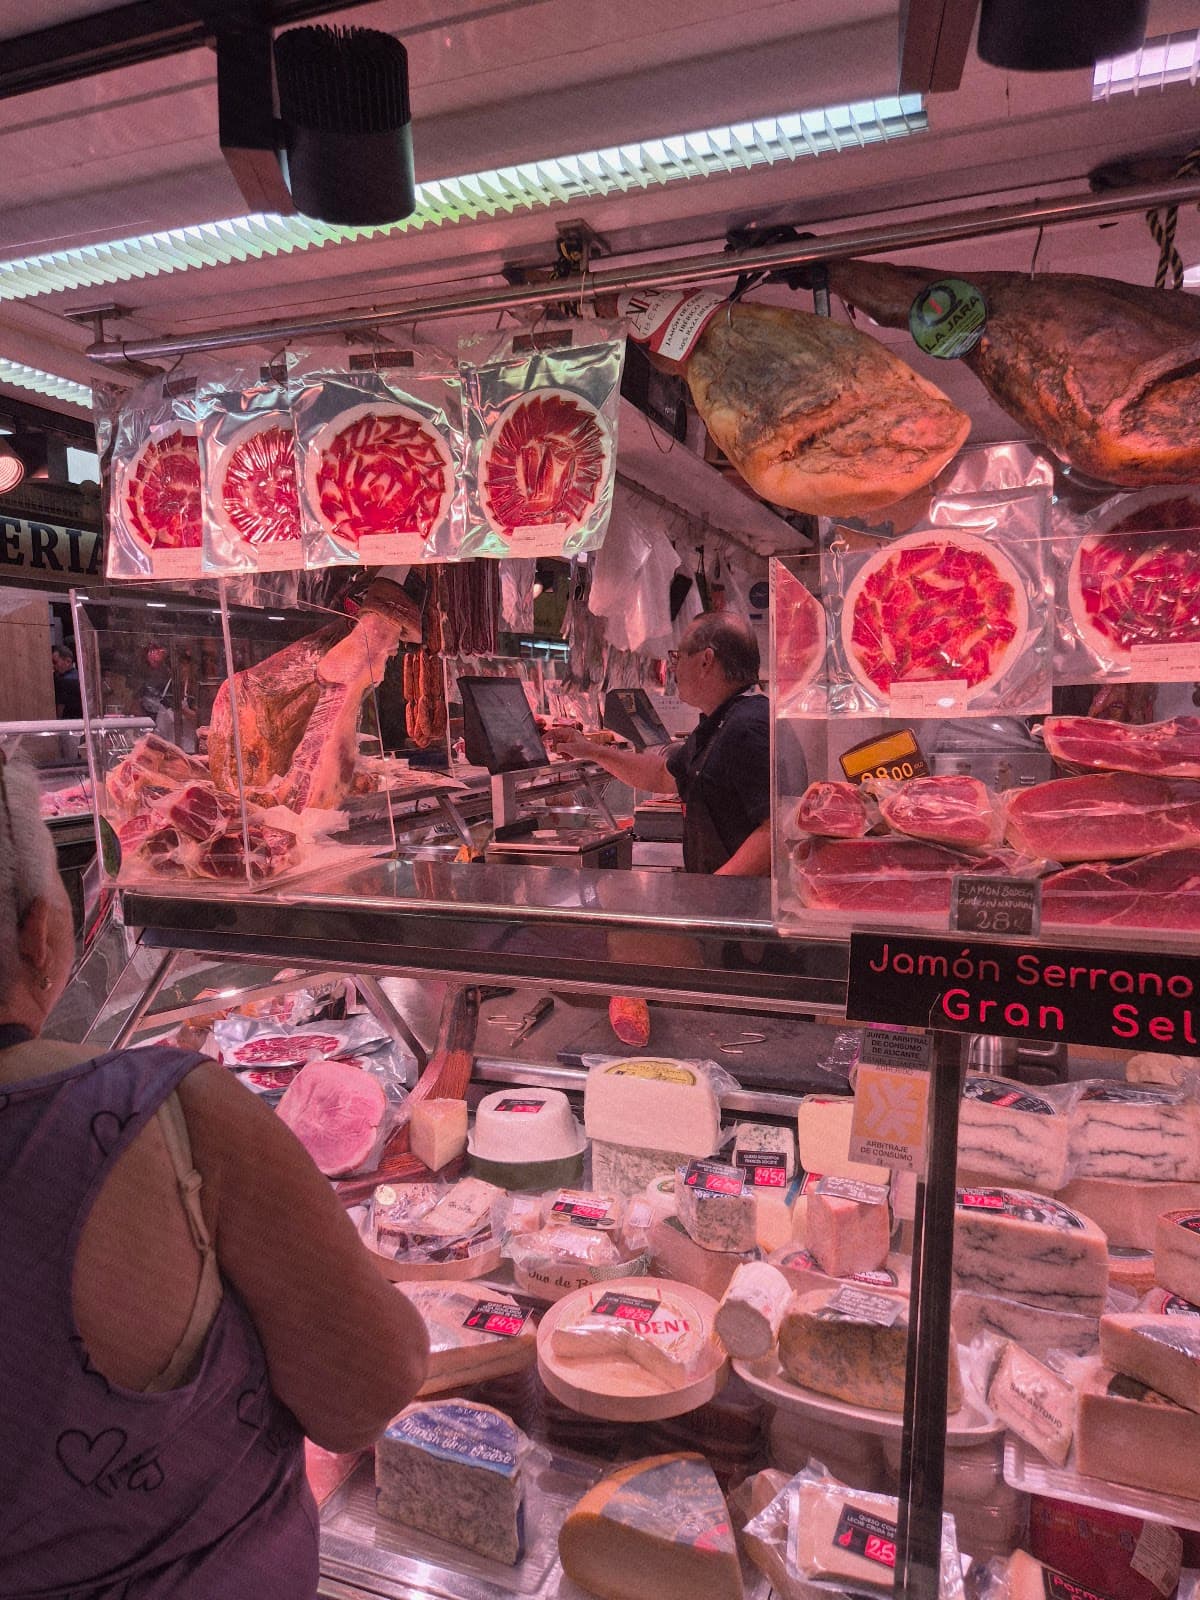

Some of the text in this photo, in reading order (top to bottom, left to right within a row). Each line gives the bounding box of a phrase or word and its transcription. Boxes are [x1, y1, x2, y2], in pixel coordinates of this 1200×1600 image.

[925, 295, 980, 351] LA JARA
[869, 944, 1194, 998] Jamón Serrano
[942, 989, 1197, 1044] Gran Sel
[866, 1031, 929, 1046] JUNTA ARBITRAL
[883, 1041, 922, 1052] CONSUMO
[883, 1048, 920, 1059] ALICANTE
[860, 1146, 913, 1161] DE CONSUMO
[866, 1140, 909, 1153] ARBITRAJE
[554, 1276, 571, 1288] de
[1027, 1397, 1063, 1429] ANTONIO
[847, 1515, 865, 1527] LECHE
[866, 1524, 886, 1535] CRUDA
[858, 1514, 880, 1527] QUESO
